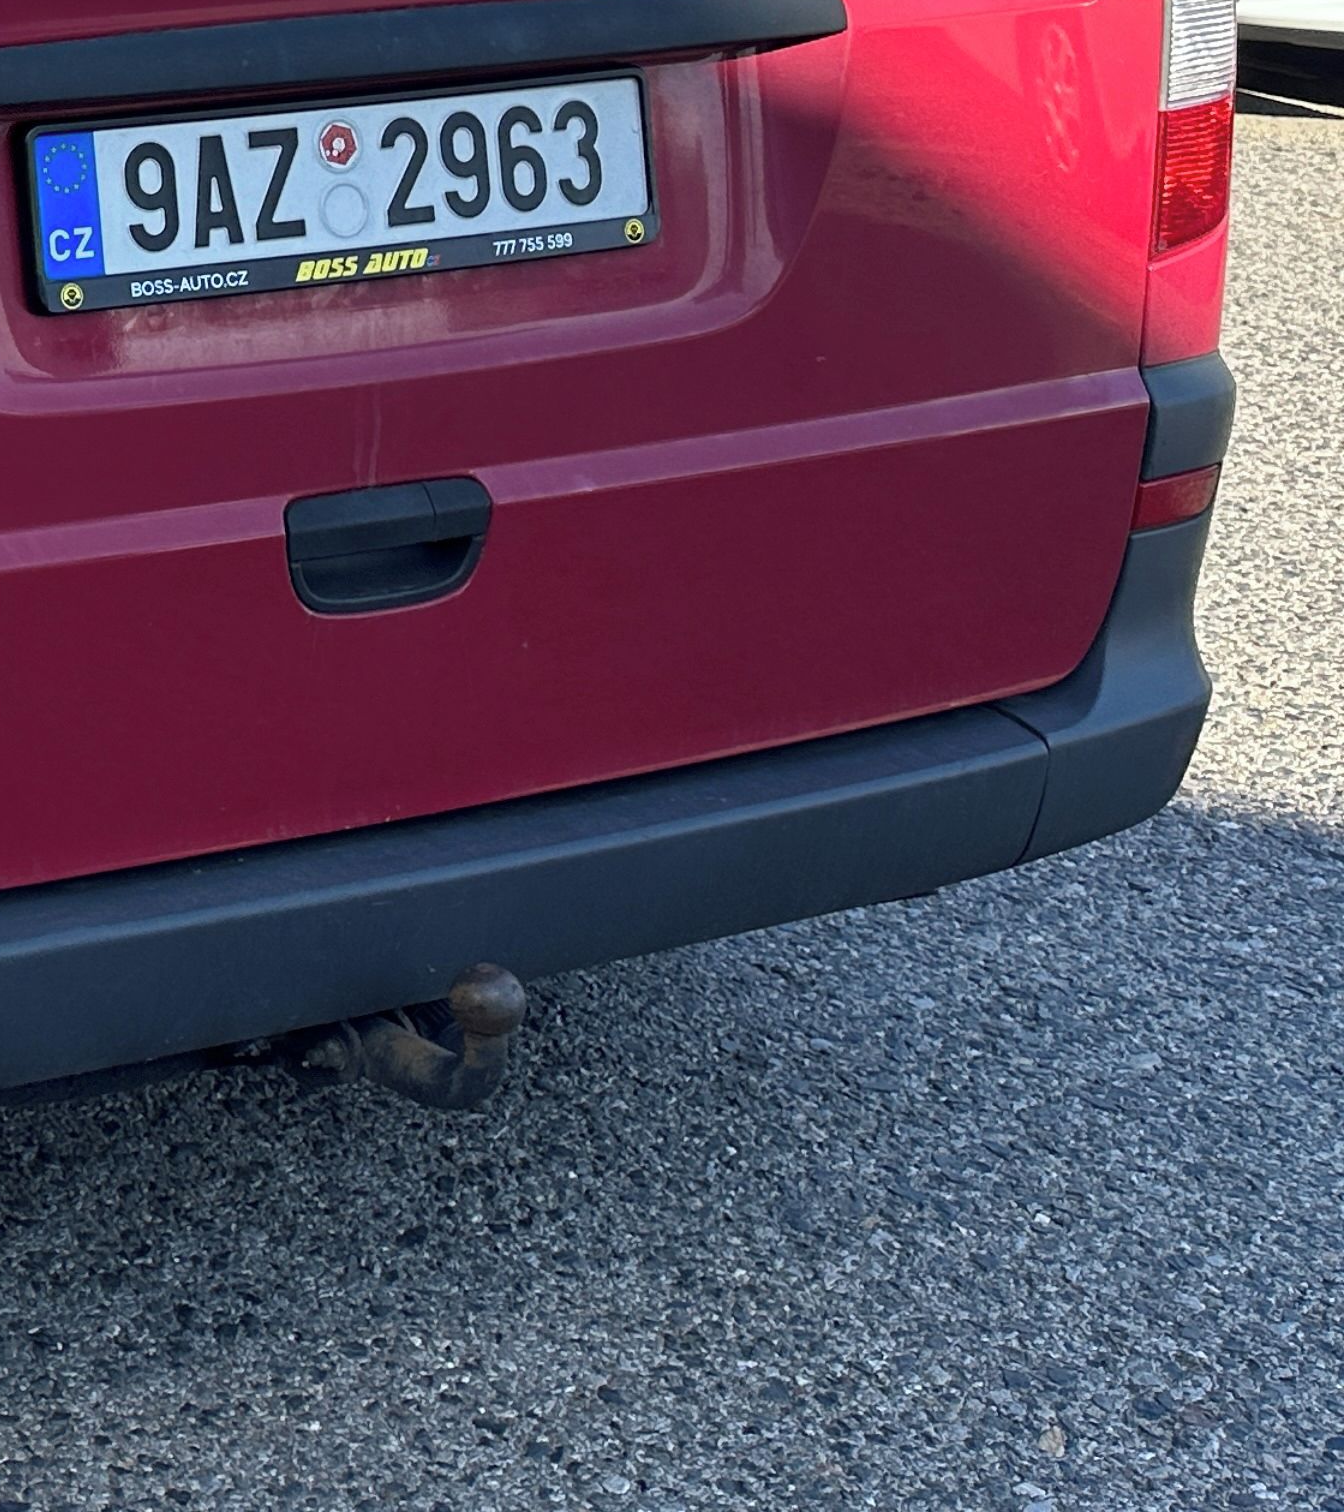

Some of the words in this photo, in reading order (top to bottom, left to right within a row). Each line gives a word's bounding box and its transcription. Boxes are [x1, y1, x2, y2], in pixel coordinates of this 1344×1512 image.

[123, 126, 307, 253] 9AZ
[379, 99, 604, 228] 2963
[48, 226, 95, 262] CZ
[493, 238, 516, 257] 777
[518, 236, 544, 253] 755
[547, 232, 573, 250] 599
[295, 255, 359, 283] BOSS
[362, 247, 429, 275] AUTO
[130, 270, 249, 299] BOSS-AUTO.CZ
